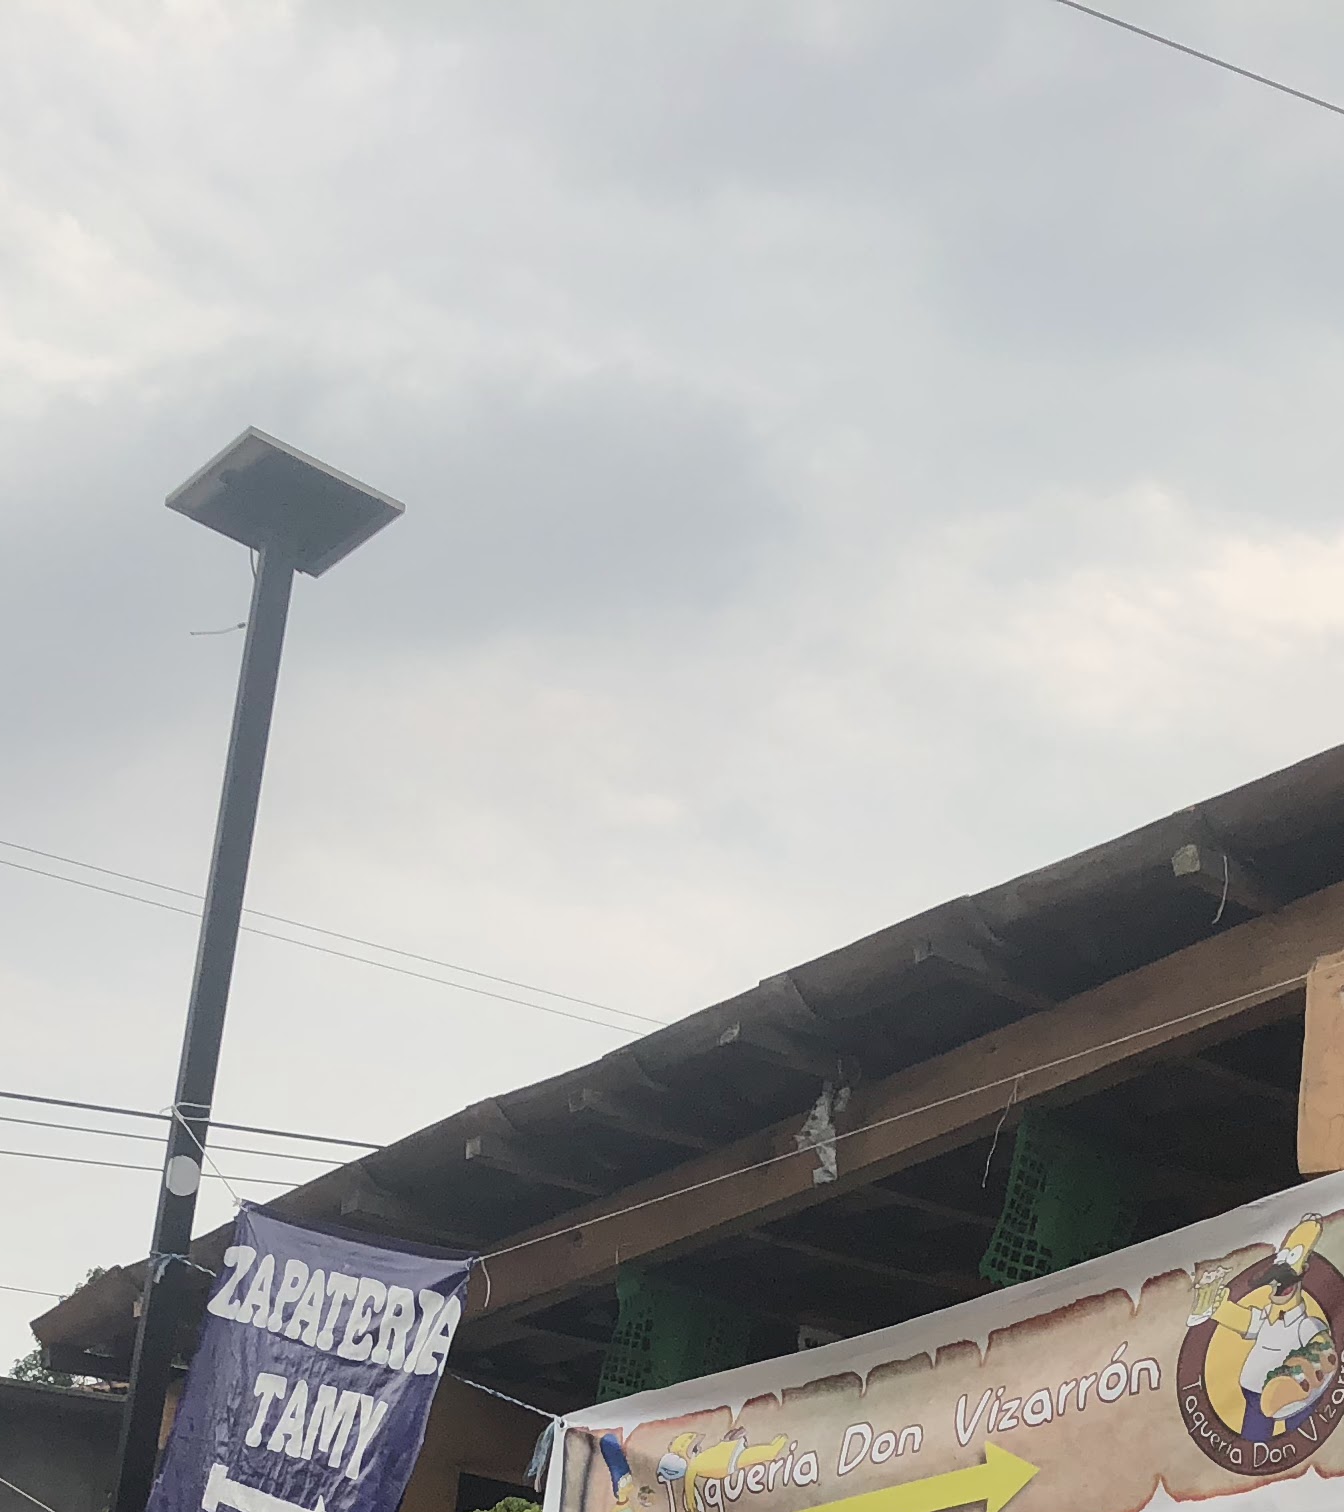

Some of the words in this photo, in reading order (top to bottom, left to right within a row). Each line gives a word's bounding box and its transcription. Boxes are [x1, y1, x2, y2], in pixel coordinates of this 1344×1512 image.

[207, 1245, 462, 1376] ZAPATERIA
[245, 1372, 389, 1481] TAMY
[837, 1421, 924, 1477] Don
[954, 1341, 1162, 1448] Vizarrón
[1182, 1374, 1243, 1465] Taqueria
[1253, 1441, 1297, 1468] Don
